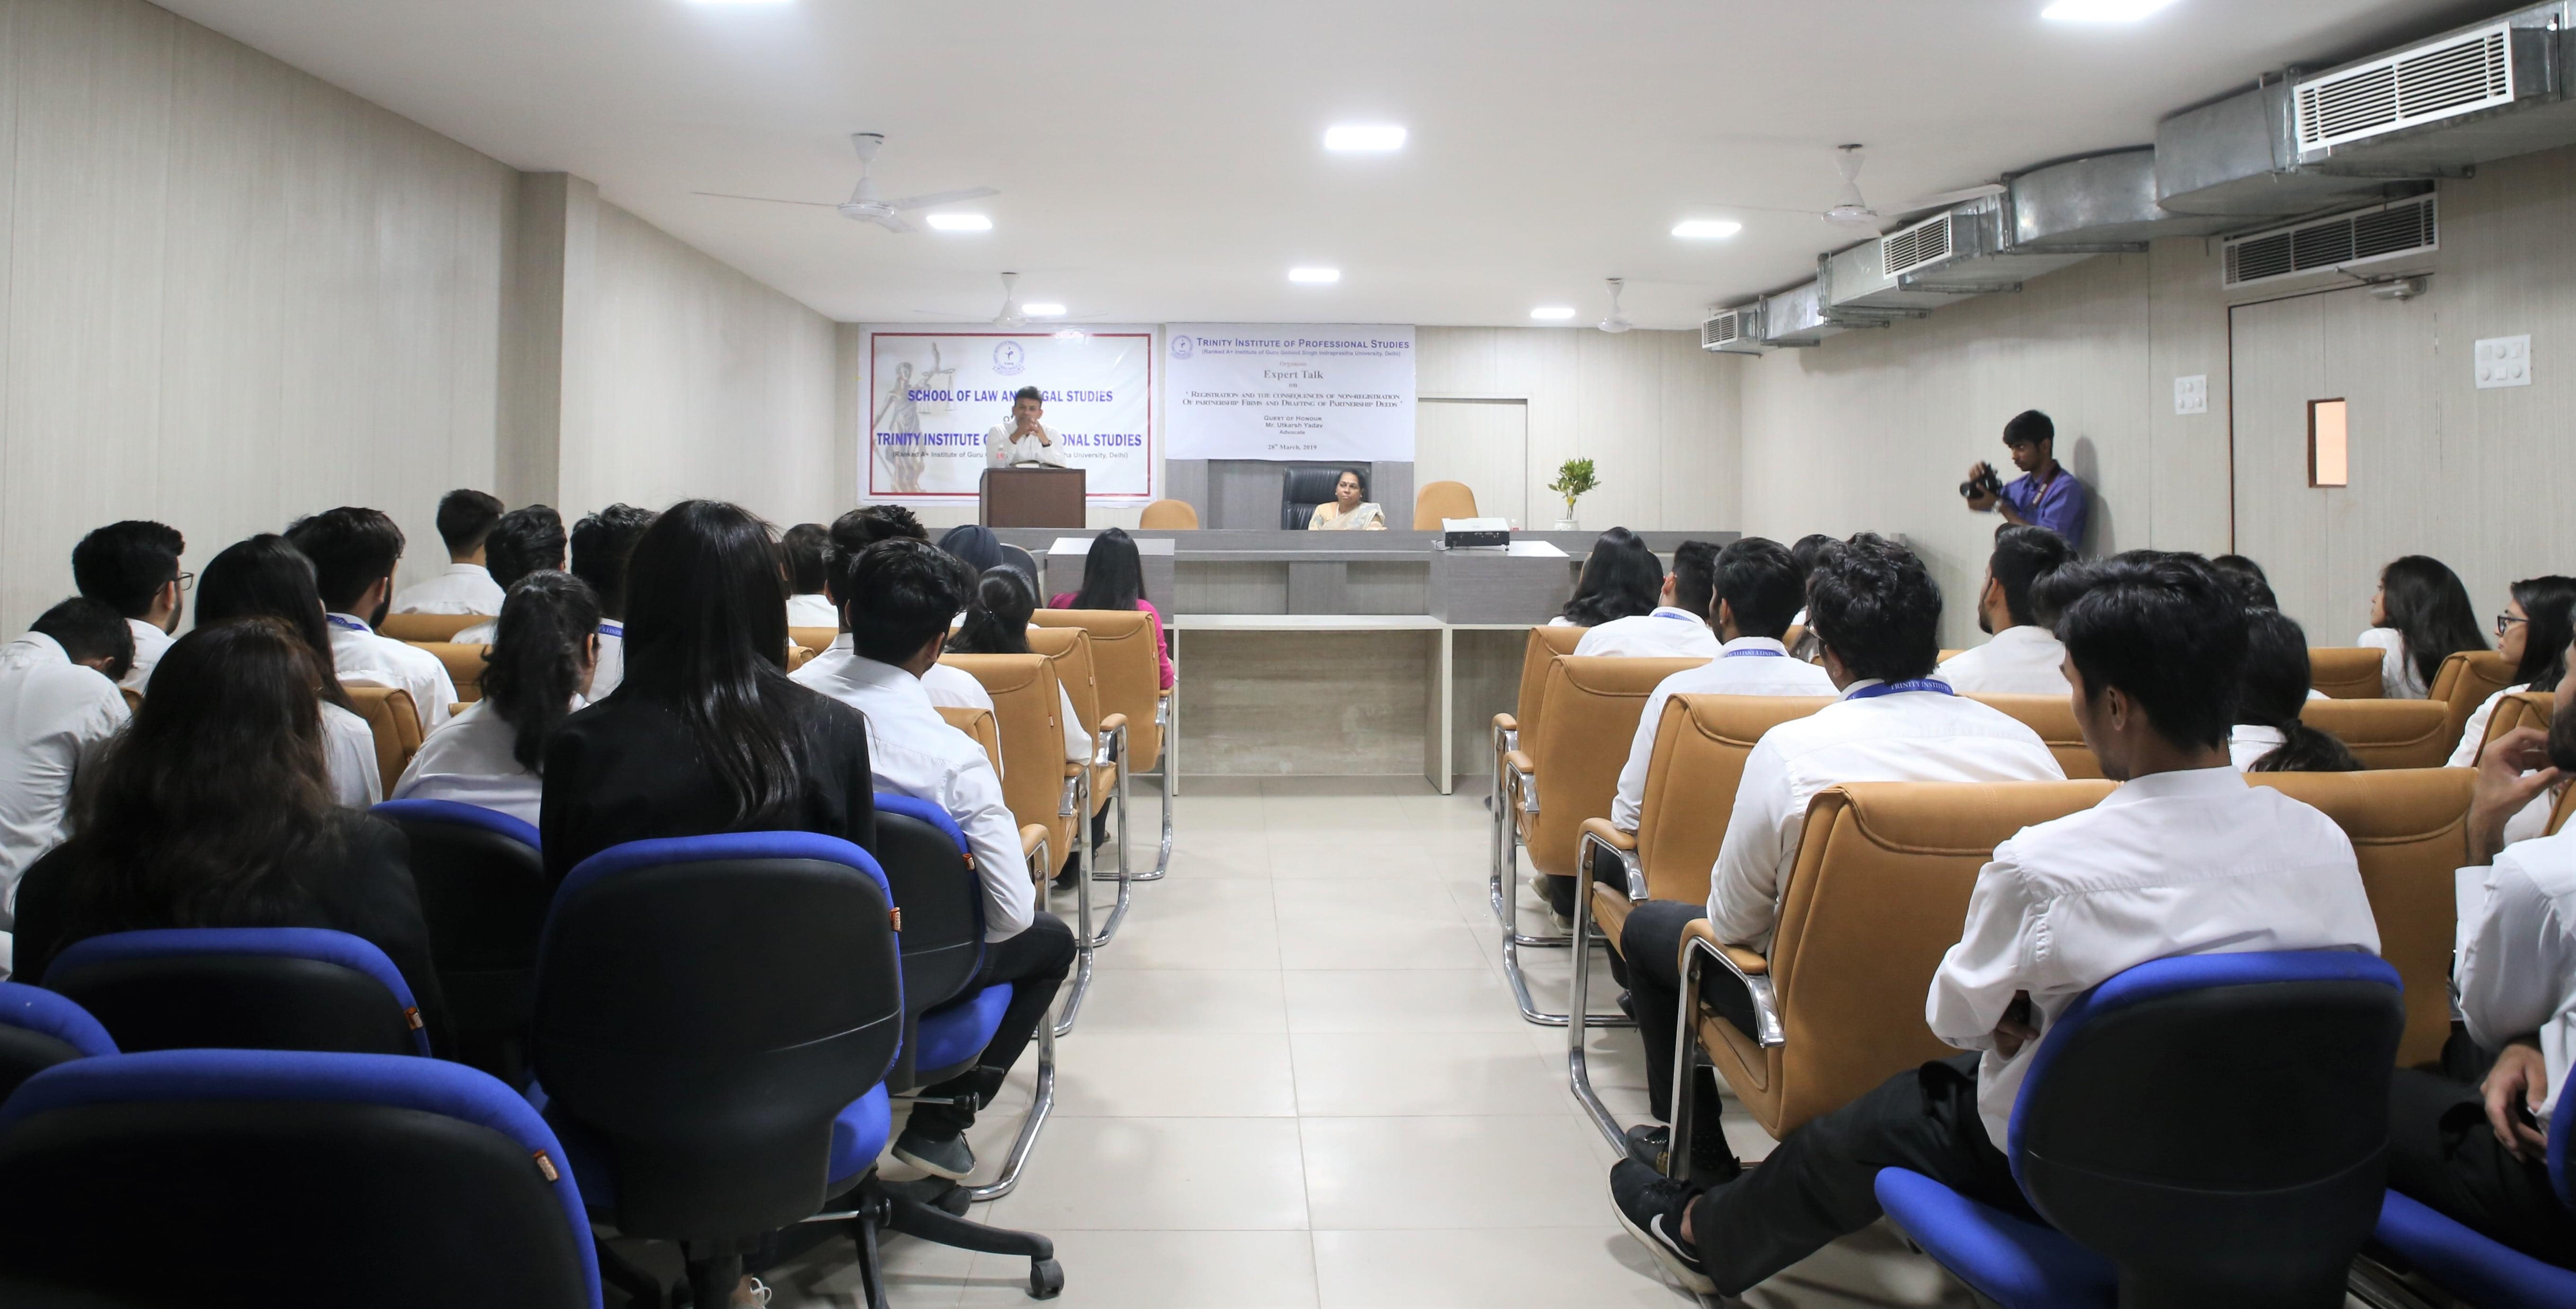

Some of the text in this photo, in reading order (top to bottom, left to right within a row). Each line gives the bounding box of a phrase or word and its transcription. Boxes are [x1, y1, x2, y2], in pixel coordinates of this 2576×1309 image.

[1196, 338, 1232, 347] TRINITY
[1235, 338, 1280, 347] INSTITUTE
[1299, 339, 1368, 348] PROFESSIONAL
[1371, 340, 1409, 349] STUDIES
[1264, 369, 1323, 380] Expert Talk
[908, 390, 1113, 402] SCHOOL OF LAW AN GAL STUDIES
[877, 433, 920, 446] TRINITY
[924, 433, 980, 446] INSTITUTE
[1094, 434, 1141, 446] STUDIES
[1891, 680, 1920, 690] TRINITY
